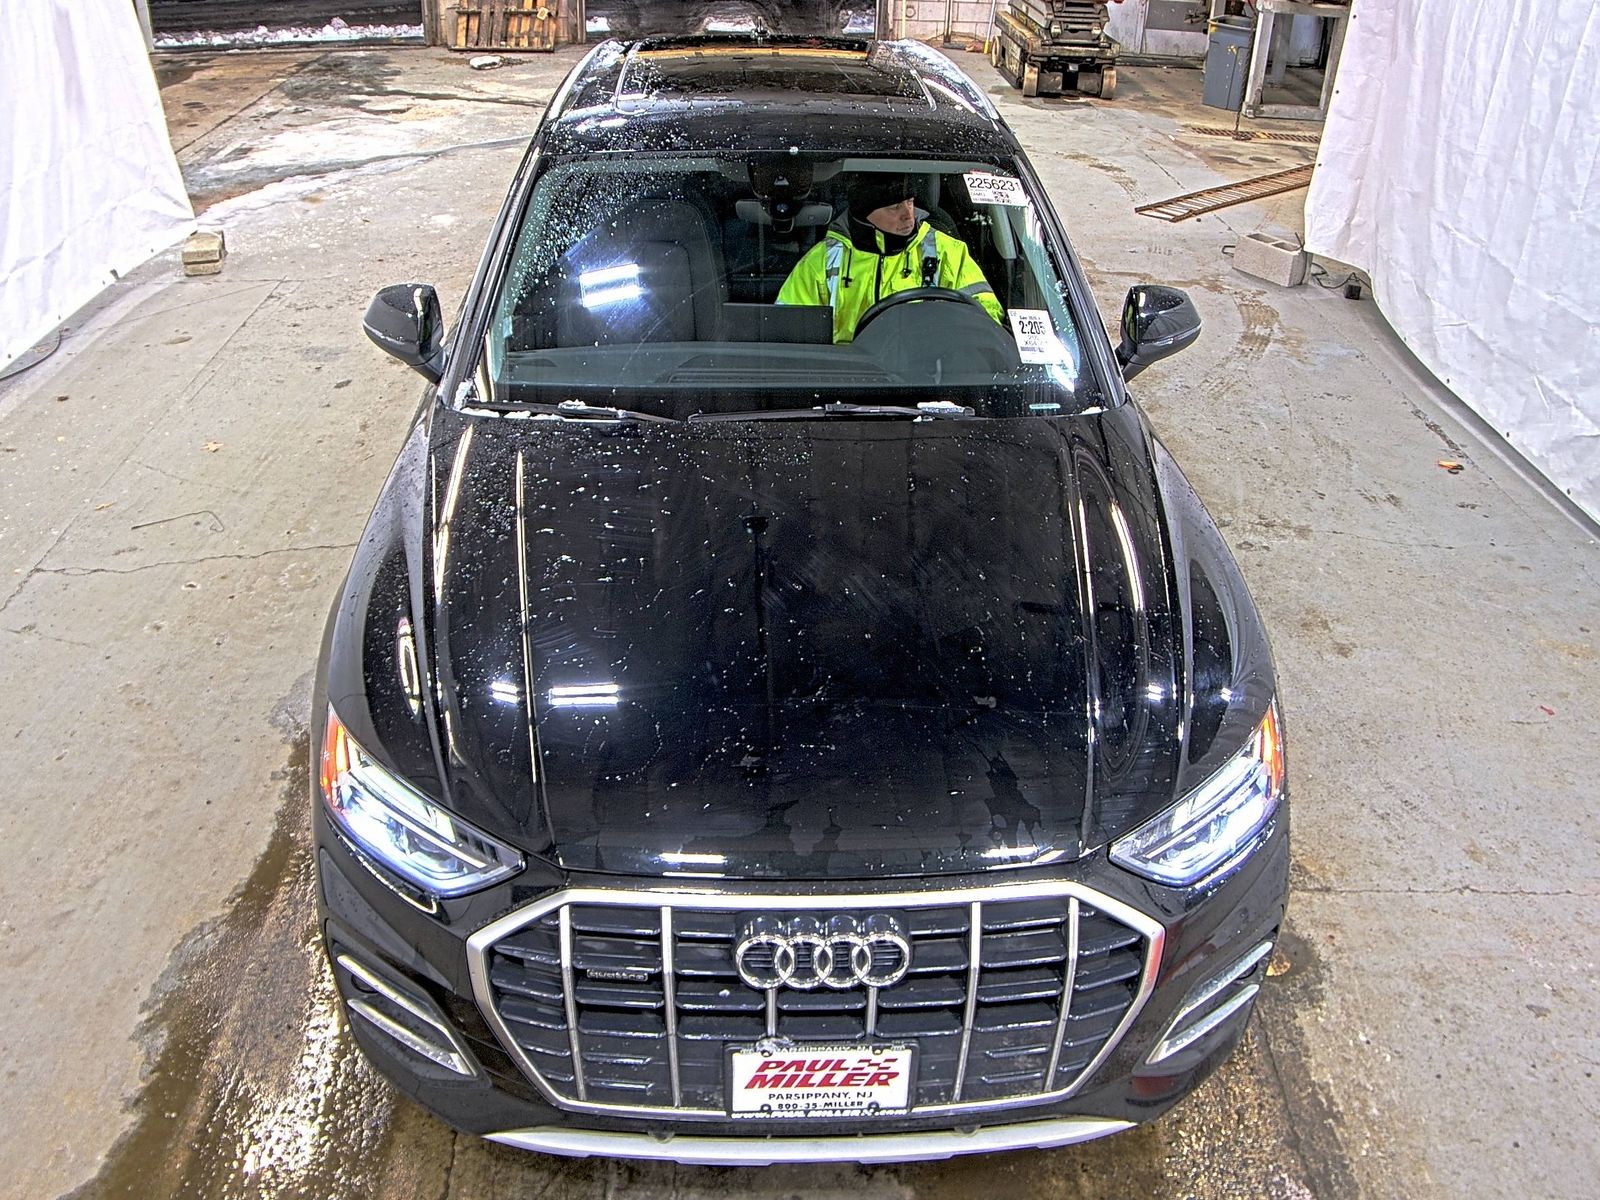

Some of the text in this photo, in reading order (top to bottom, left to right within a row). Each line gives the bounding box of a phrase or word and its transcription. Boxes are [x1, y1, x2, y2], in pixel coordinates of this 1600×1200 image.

[588, 970, 646, 981] quattro
[755, 1059, 848, 1073] PAUL
[744, 1072, 899, 1089] MILLER
[768, 1091, 873, 1100] PARSIPPANY, NJ
[777, 1101, 863, 1109] 800-35-MILLER
